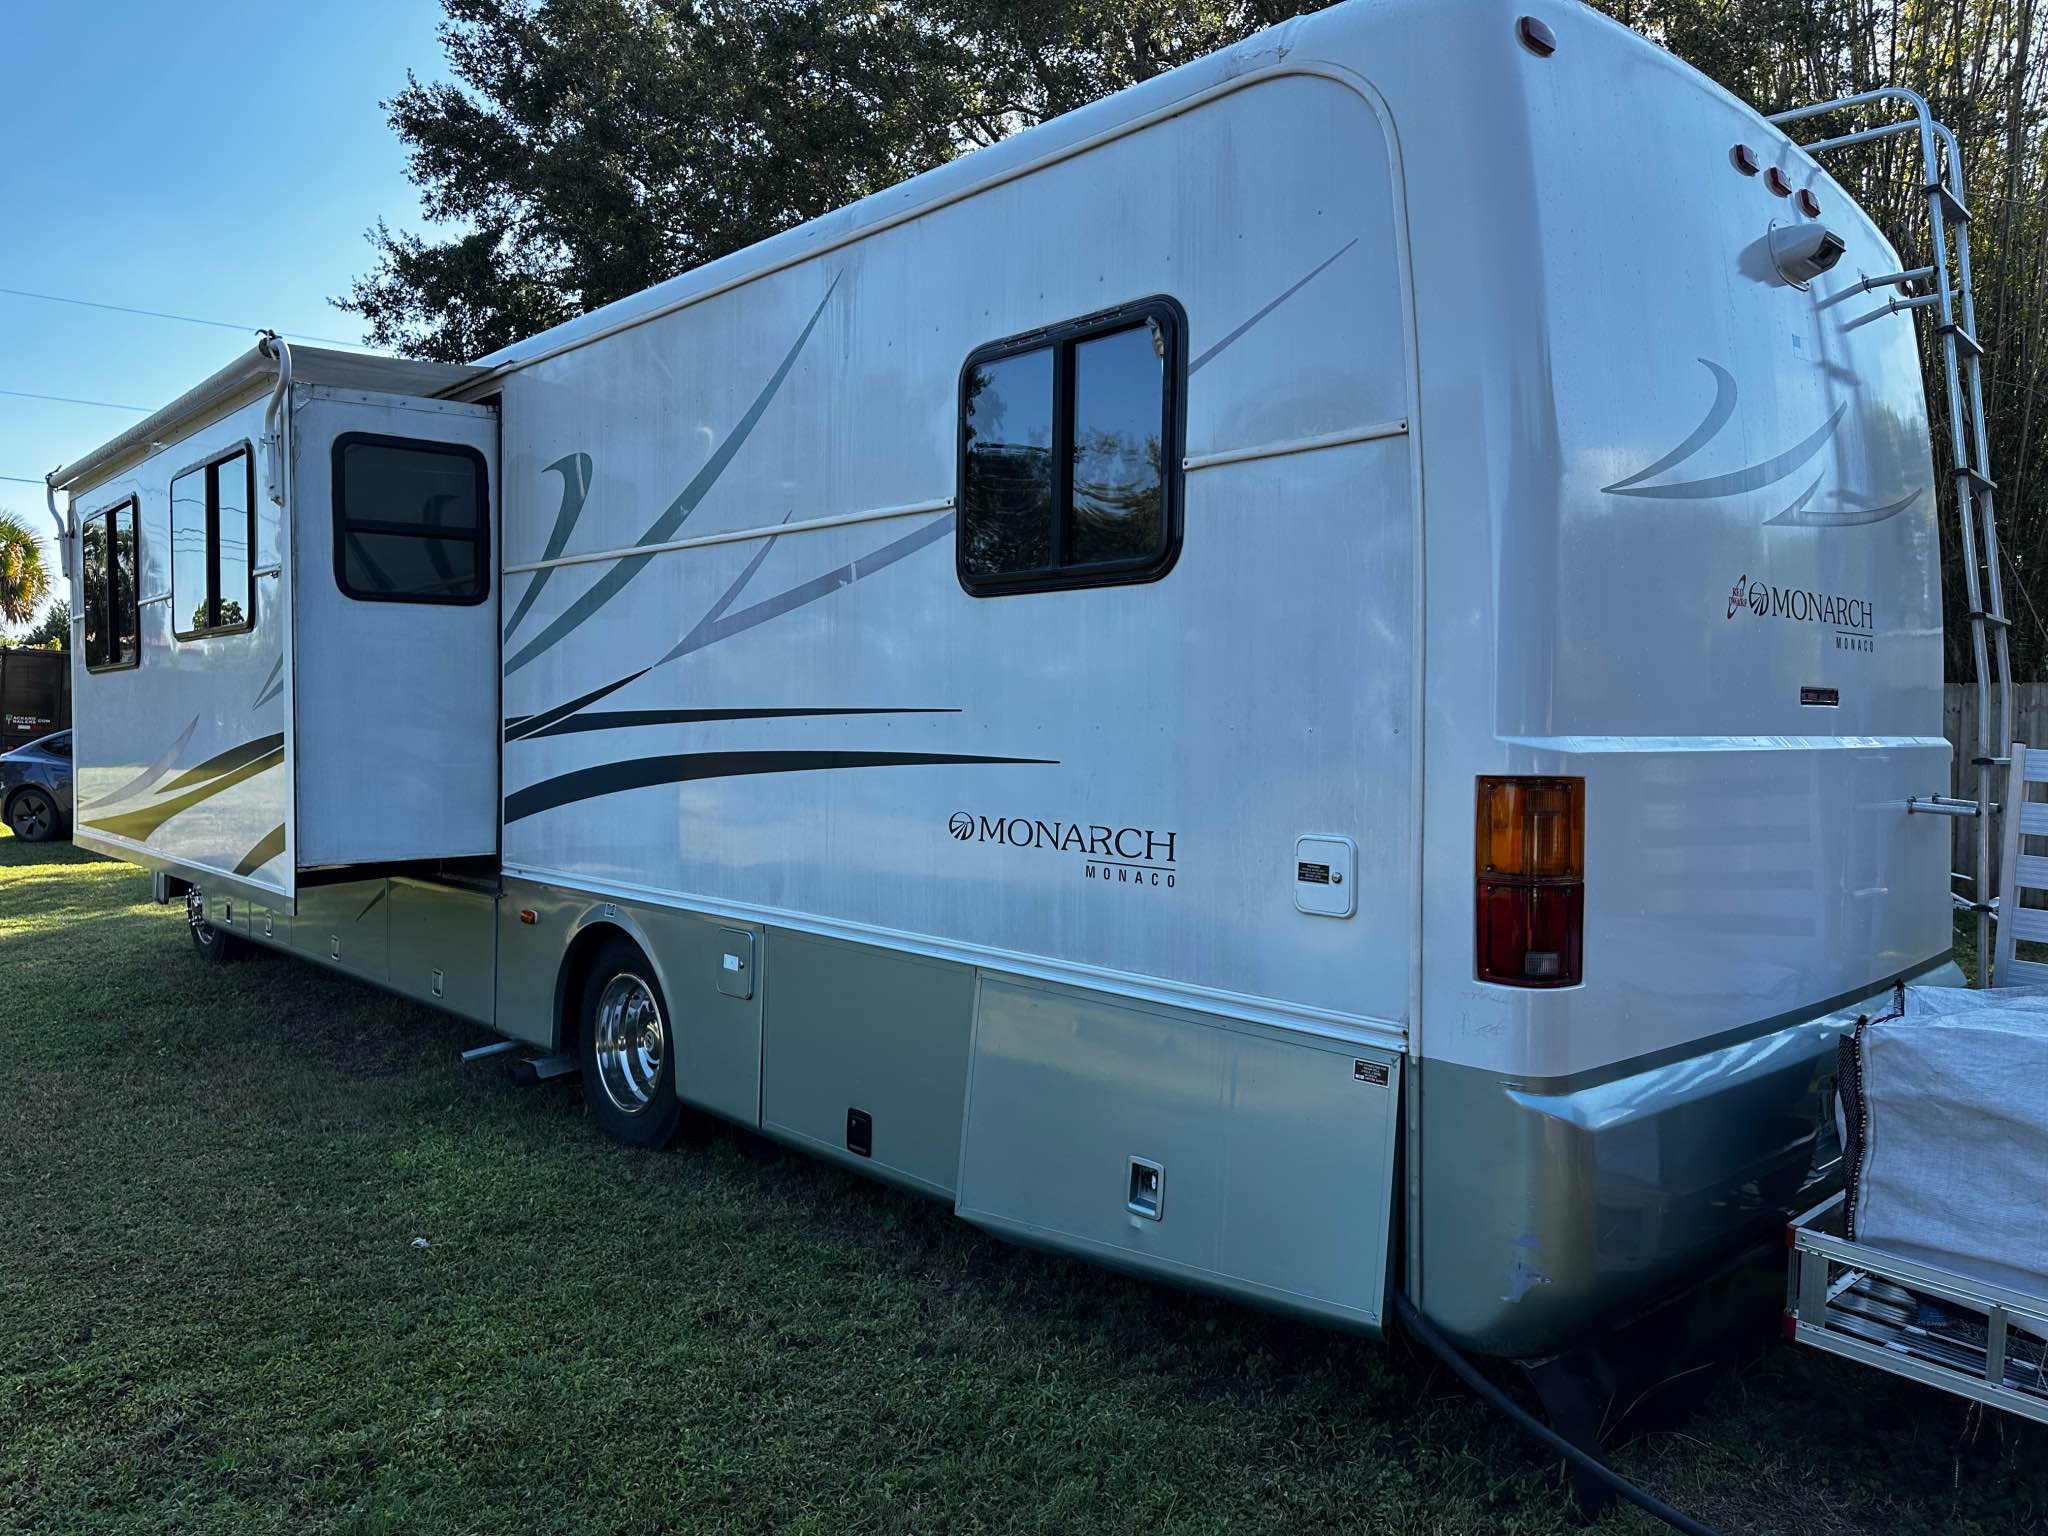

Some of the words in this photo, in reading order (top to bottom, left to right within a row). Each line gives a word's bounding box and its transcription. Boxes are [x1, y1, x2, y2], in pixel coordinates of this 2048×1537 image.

[1772, 587, 1873, 629] MONARCH
[1836, 636, 1874, 653] MONACO
[978, 815, 1177, 862] MONARCH
[1085, 865, 1175, 888] MONACO
